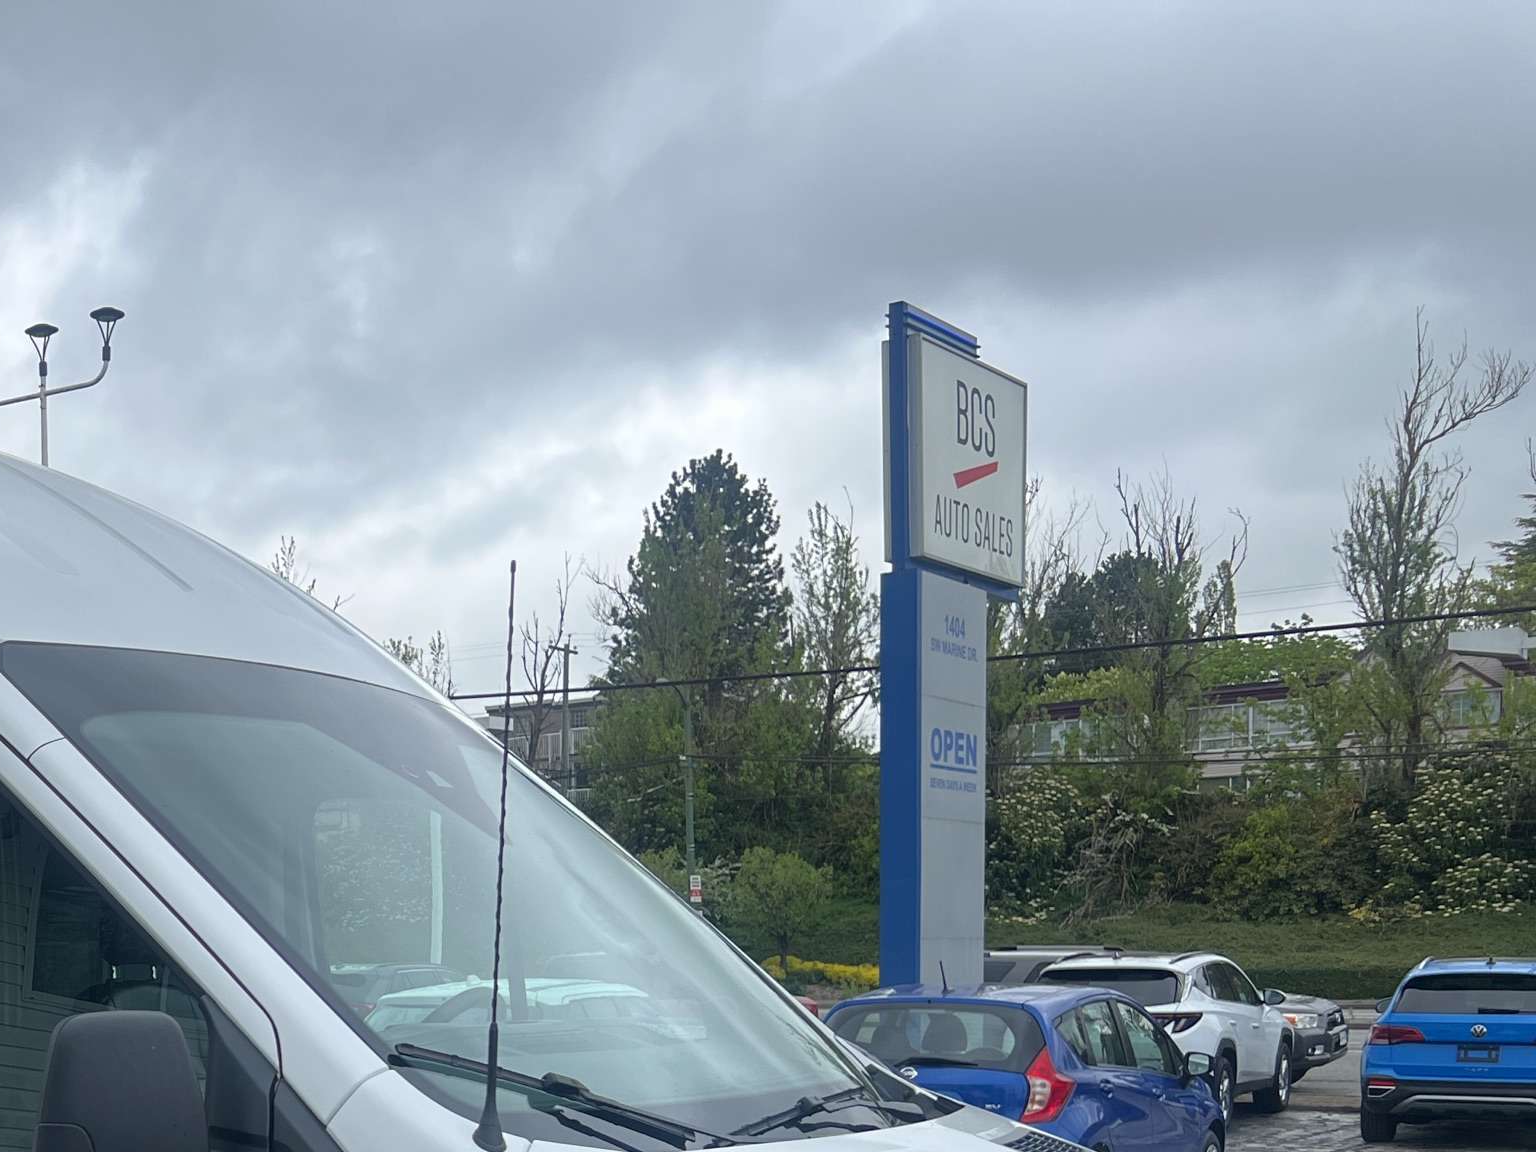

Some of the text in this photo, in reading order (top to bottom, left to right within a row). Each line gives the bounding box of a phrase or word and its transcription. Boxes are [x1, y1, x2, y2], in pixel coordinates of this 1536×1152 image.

[956, 379, 996, 458] BCS
[934, 494, 1013, 558] AUTO SALES
[944, 614, 966, 640] 1404
[930, 727, 977, 767] OPEN
